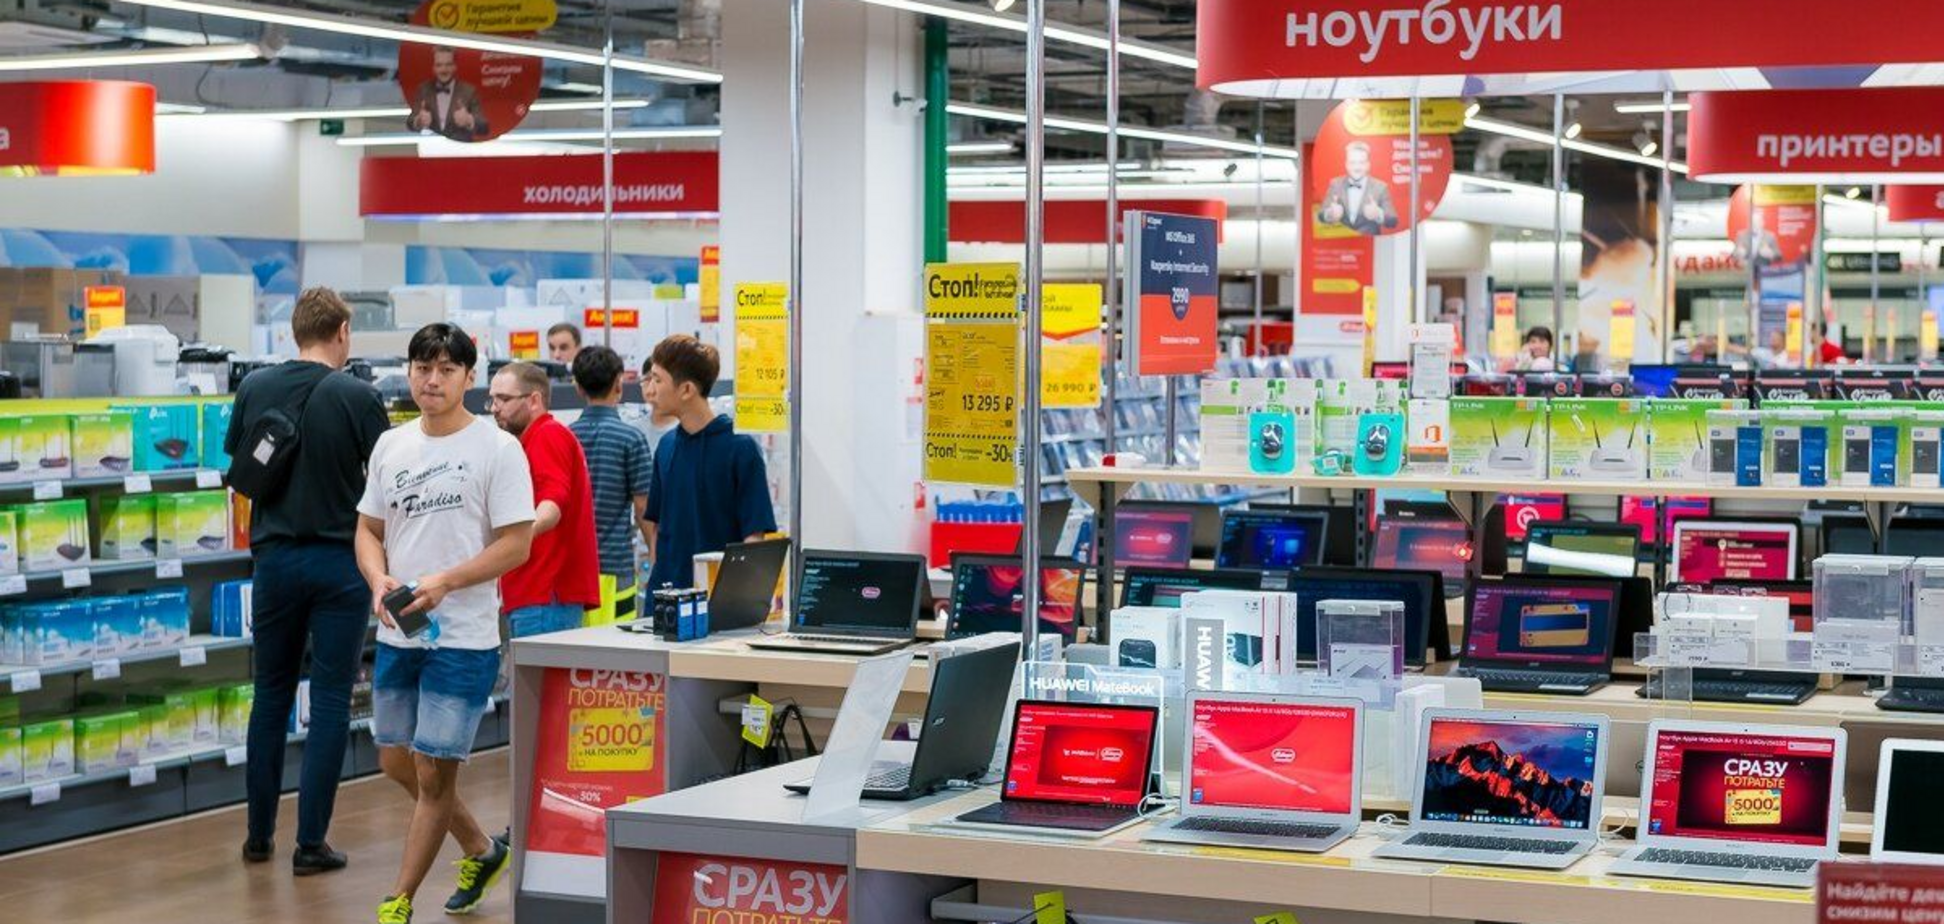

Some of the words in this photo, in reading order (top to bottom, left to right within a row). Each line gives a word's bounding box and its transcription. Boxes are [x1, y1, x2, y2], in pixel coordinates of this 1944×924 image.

[1286, 0, 1561, 63] ноутбуки
[1756, 133, 1942, 168] принтеры
[929, 272, 979, 298] Стоп!
[962, 394, 974, 411] 13
[977, 394, 1000, 412] 295
[926, 442, 956, 459] Стоп!
[1196, 626, 1212, 690] HUAW
[570, 668, 664, 692] СРАЗУ
[1030, 677, 1090, 691] HUAWEI
[1092, 679, 1155, 696] MateBook
[568, 688, 664, 711] ПОТРАТЬТЕ
[582, 723, 643, 747] 5000
[1724, 758, 1789, 777] СРАЗУ
[1724, 775, 1786, 789] ПОТРАТЬТЕ
[1733, 798, 1773, 811] 5000
[693, 863, 847, 917] СРАЗУ
[1826, 882, 1910, 902] Найдёте
[1826, 905, 1898, 920] снизим
